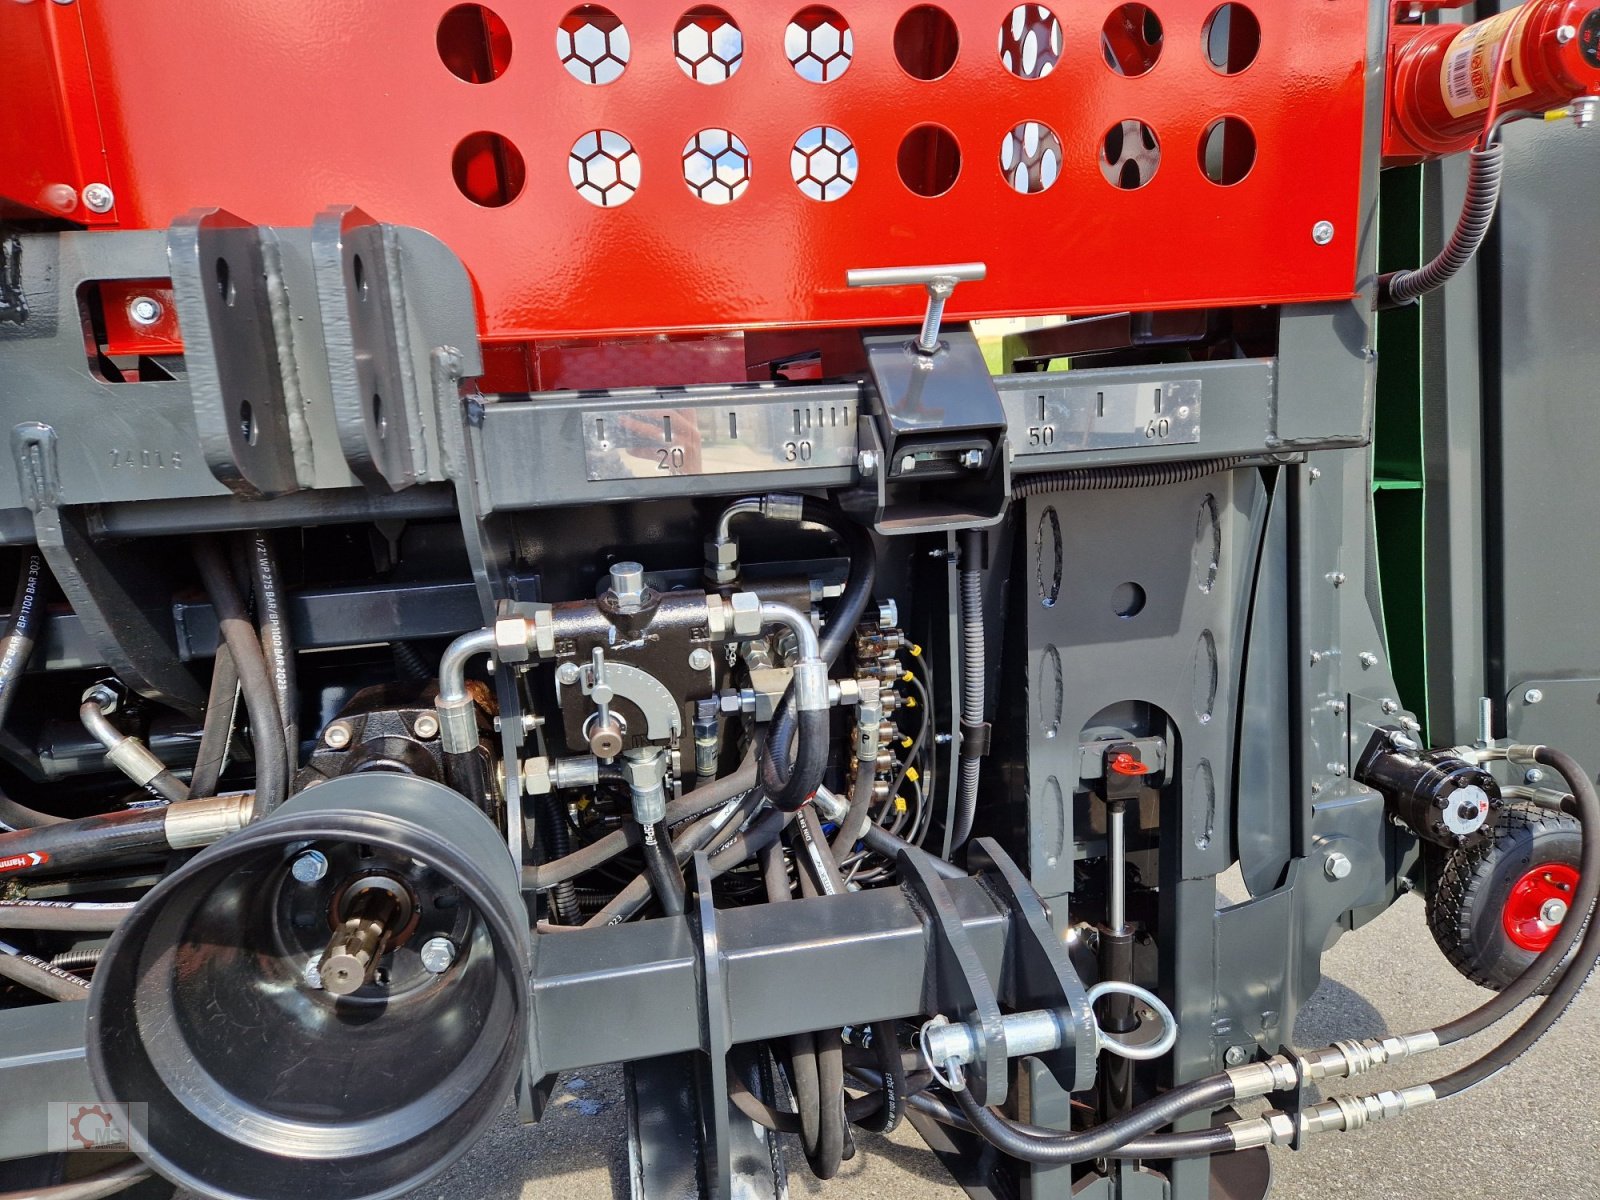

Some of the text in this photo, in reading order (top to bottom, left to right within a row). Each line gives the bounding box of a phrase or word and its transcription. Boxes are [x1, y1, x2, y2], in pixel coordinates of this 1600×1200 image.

[656, 419, 1169, 469] 20 30 50 60
[260, 558, 270, 573] WP
[26, 577, 38, 594] BAR
[262, 574, 273, 589] 275
[22, 595, 33, 614] 1100
[17, 615, 28, 629] BP
[271, 627, 282, 646] 1100
[9, 637, 21, 656] BAR
[274, 648, 285, 666] BAR
[275, 668, 287, 690] 2Q23
[800, 819, 808, 830] EN
[803, 828, 812, 841] DIN
[22, 955, 39, 965] DIN
[38, 961, 52, 971] EN
[50, 967, 67, 978] 853
